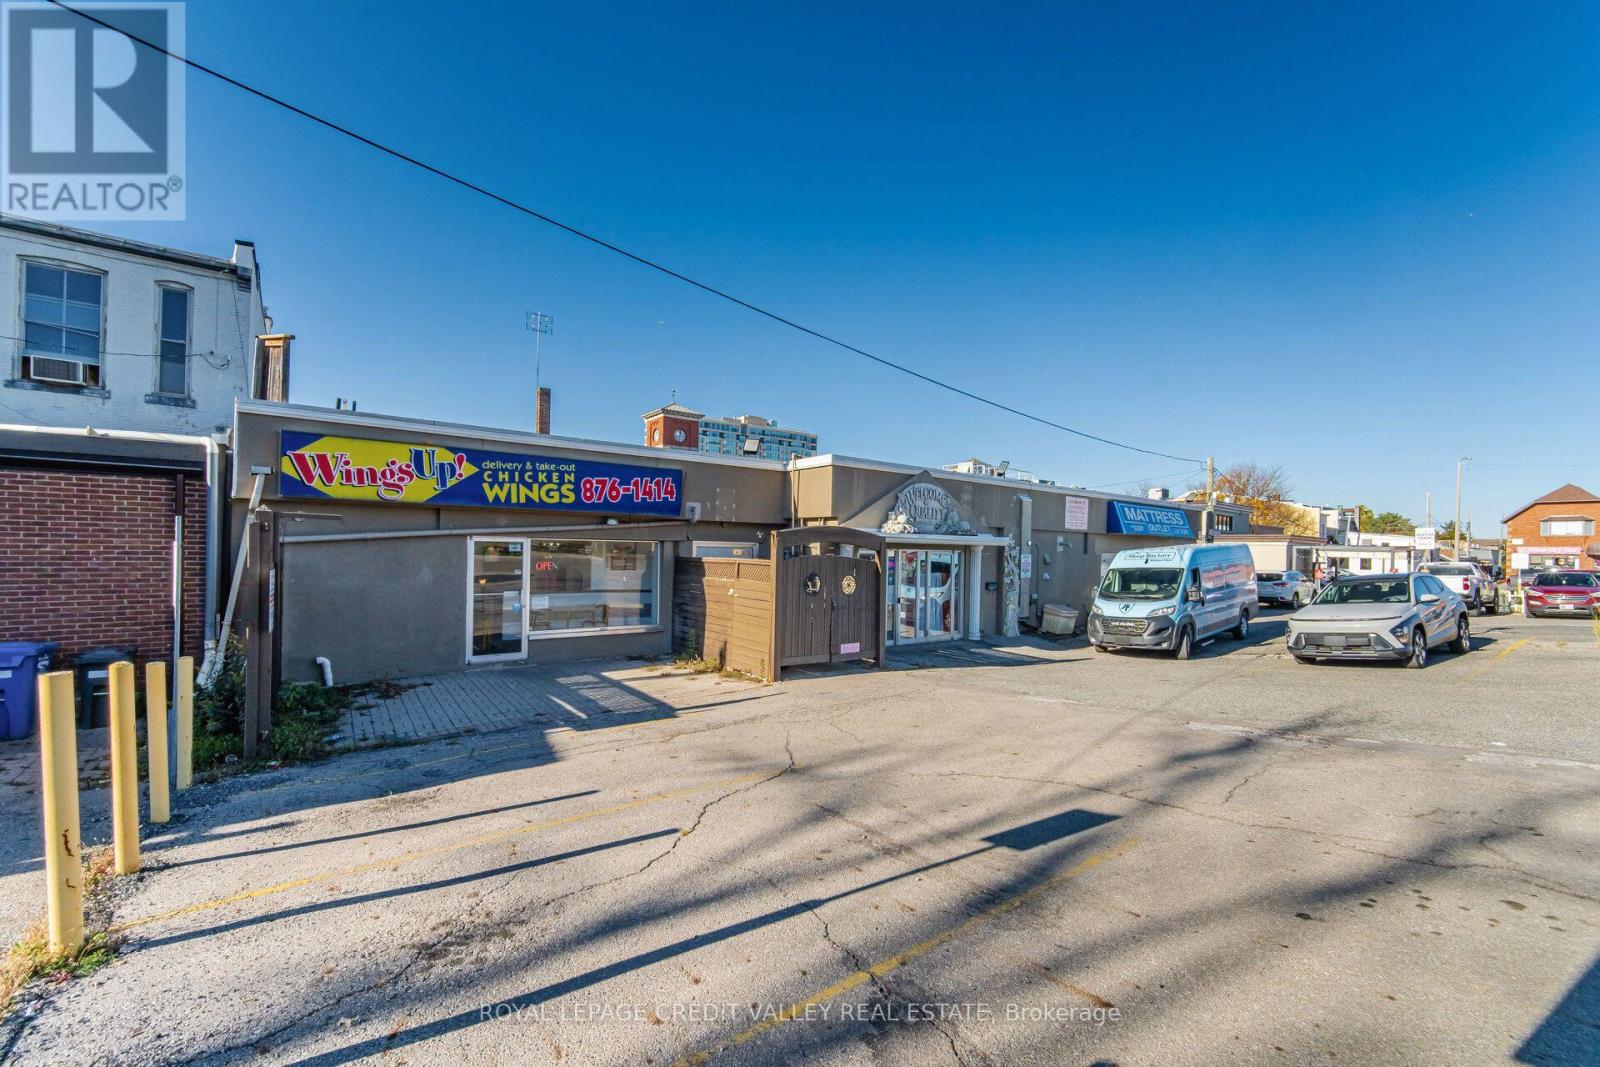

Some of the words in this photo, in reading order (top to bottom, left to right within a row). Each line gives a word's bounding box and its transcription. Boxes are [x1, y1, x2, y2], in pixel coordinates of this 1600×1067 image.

[482, 460, 523, 472] delivery
[525, 461, 533, 470] &
[535, 461, 576, 472] take-out
[483, 470, 575, 483] CHICKEN
[482, 482, 576, 504] WINGS
[581, 477, 676, 504] 876-1414
[904, 486, 951, 507] WELCOME
[1124, 507, 1184, 526] MATTRESS
[1148, 523, 1171, 533] OUTLET
[535, 560, 560, 571] OPEN
